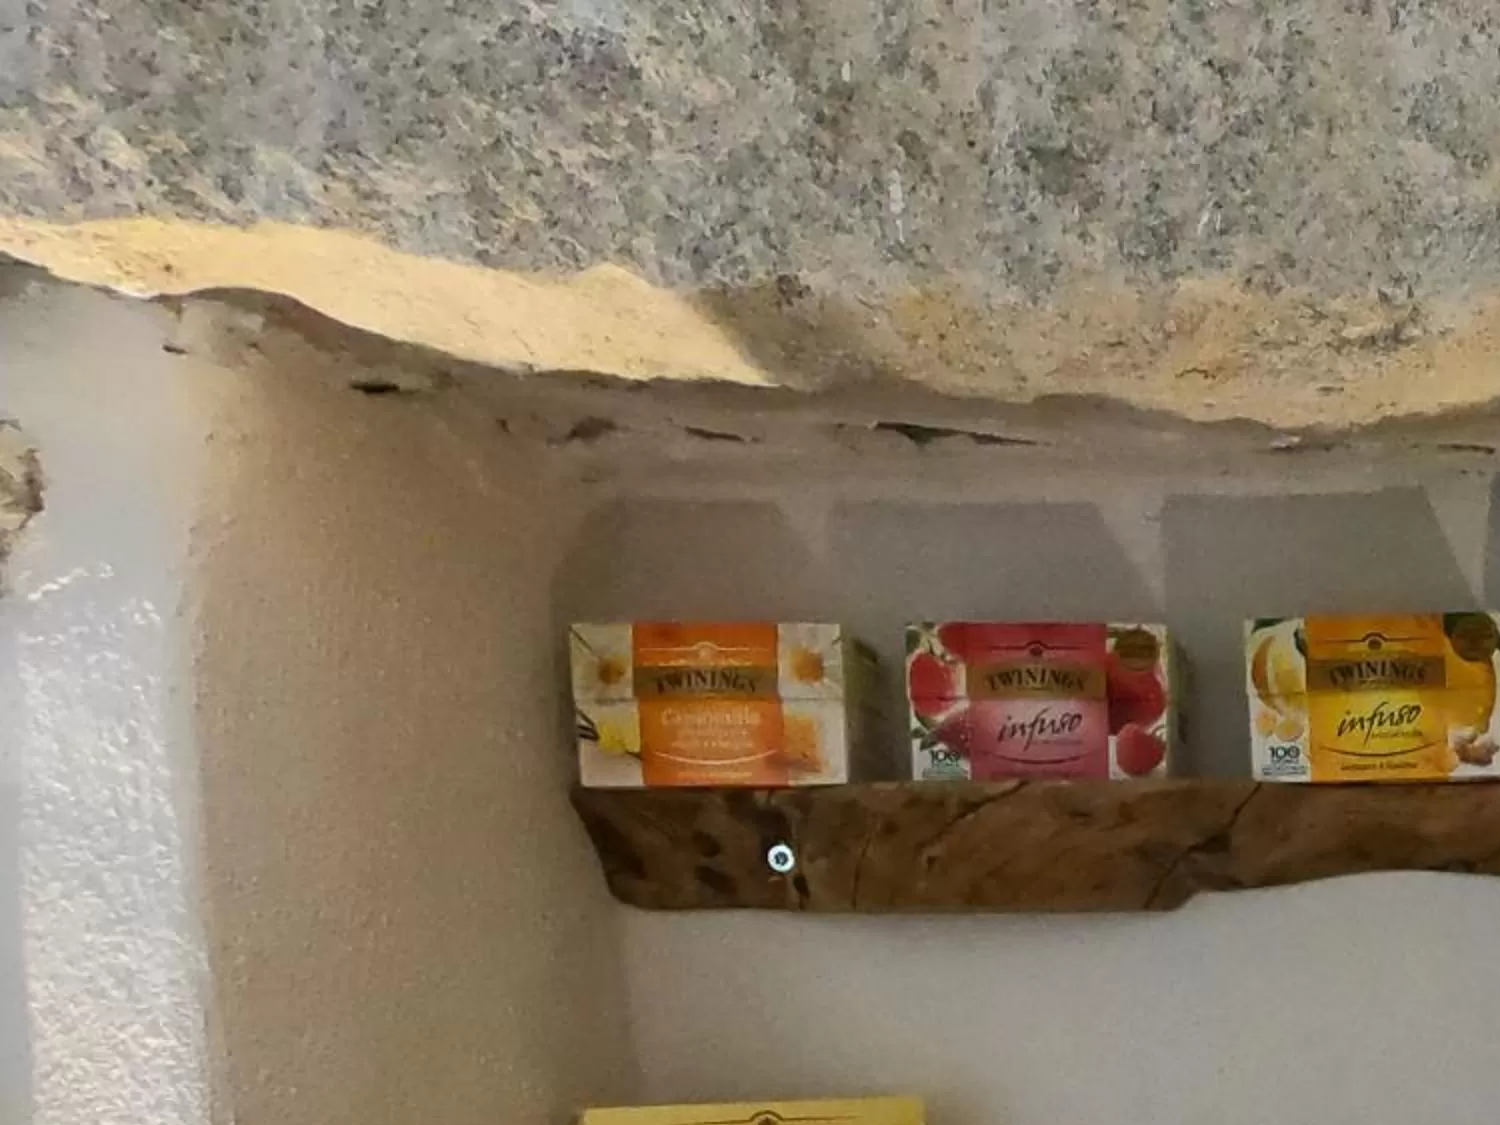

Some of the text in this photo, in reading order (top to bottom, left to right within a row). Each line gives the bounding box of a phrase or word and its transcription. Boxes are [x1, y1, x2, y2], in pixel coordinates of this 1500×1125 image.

[655, 669, 757, 695] TWININGS
[986, 667, 1086, 692] TWININGS
[1329, 658, 1427, 686] TWININGS
[997, 707, 1083, 751] infuso
[1337, 701, 1422, 746] infuso
